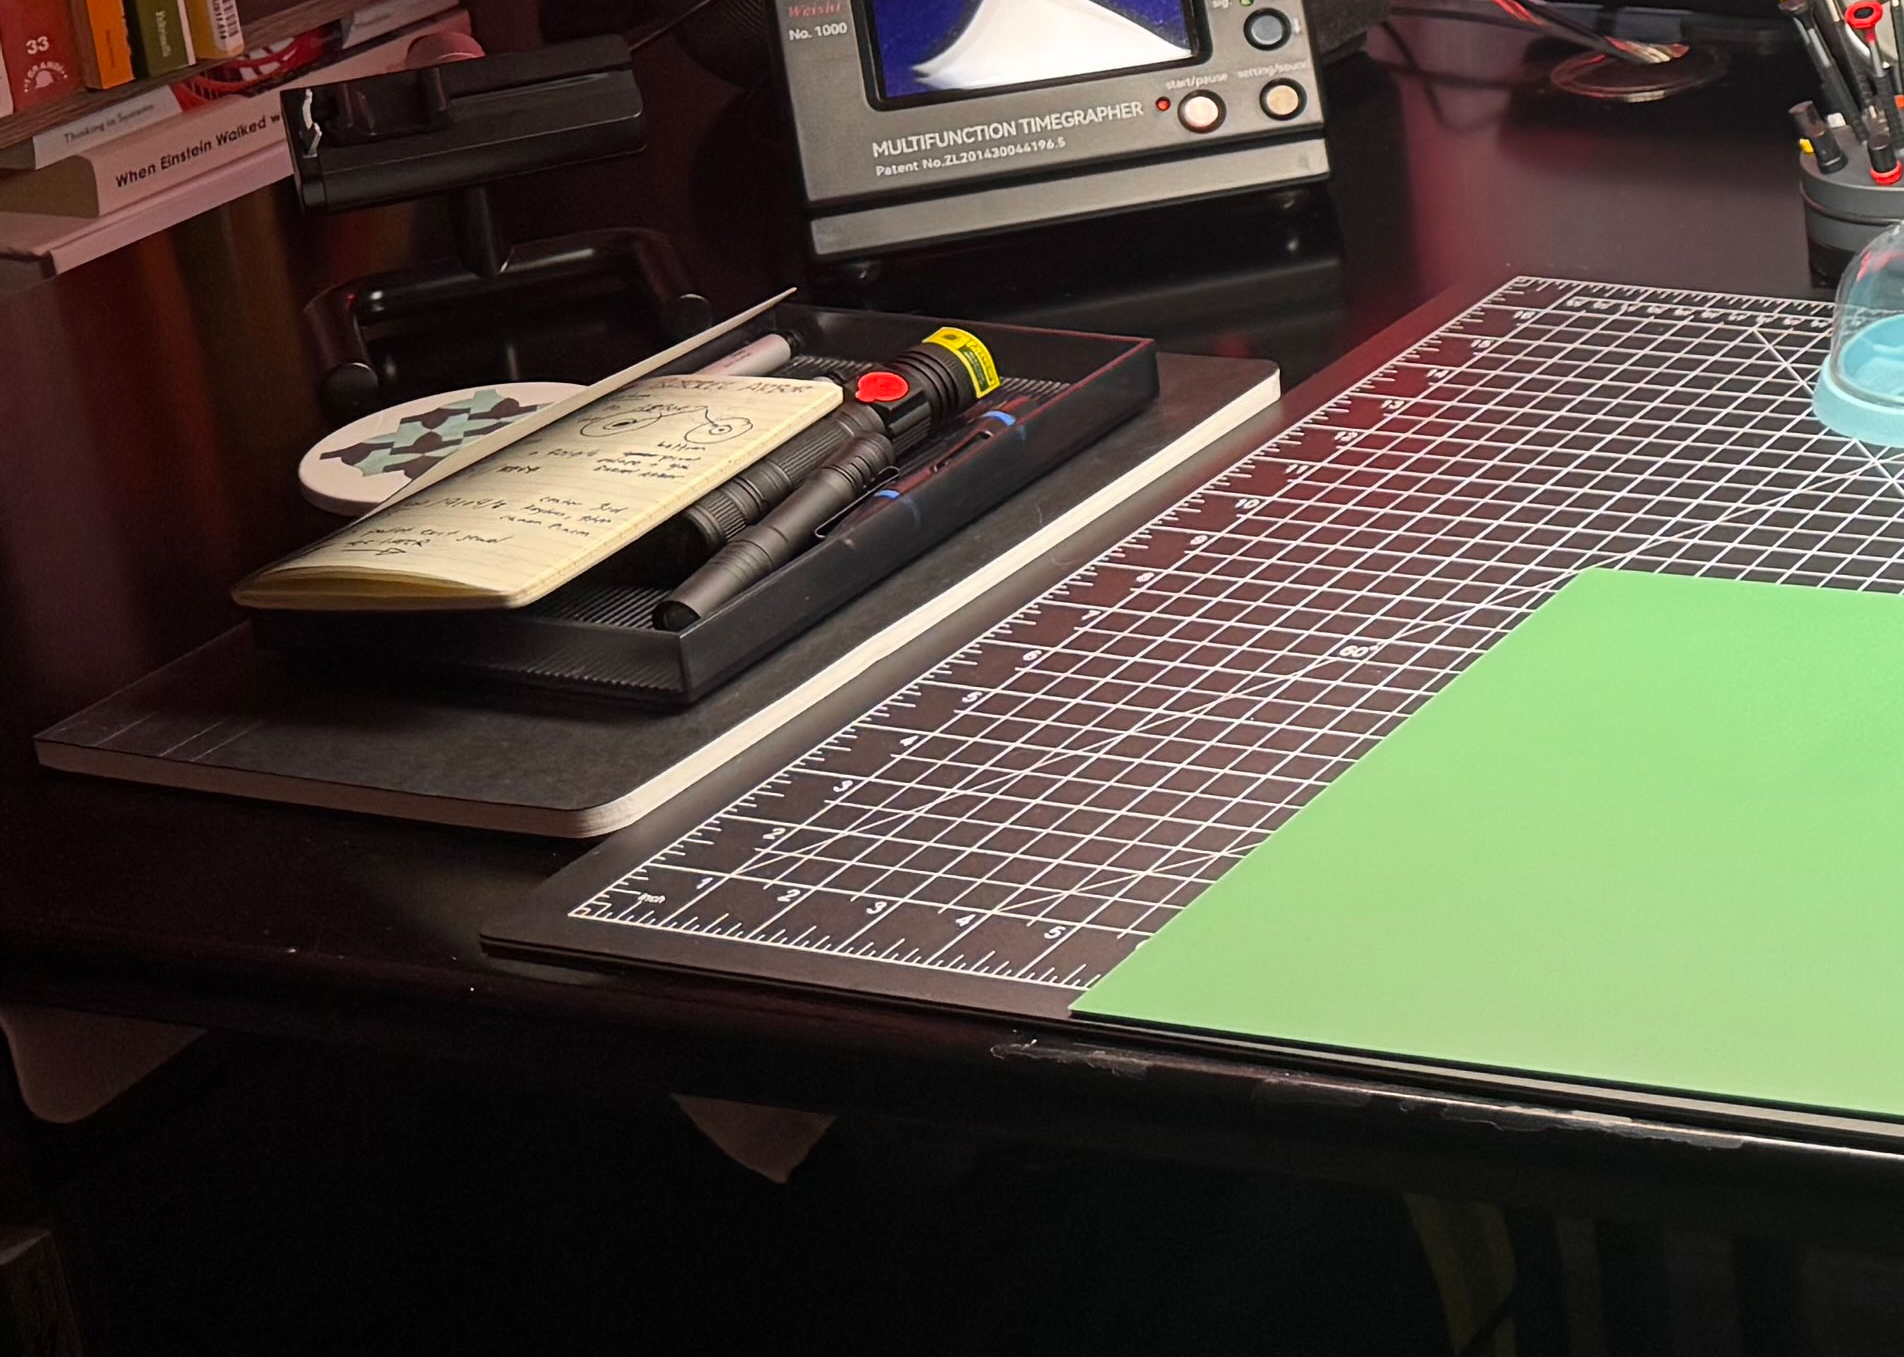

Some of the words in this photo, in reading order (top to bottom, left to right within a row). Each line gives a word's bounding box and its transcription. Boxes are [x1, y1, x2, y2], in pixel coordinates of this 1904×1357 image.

[788, 27, 812, 41] No.
[814, 21, 848, 39] 1000
[26, 36, 50, 55] 33
[1165, 72, 1229, 91] start/pause
[872, 119, 1017, 159] MULTIFUNCTION
[1020, 100, 1145, 137] TIMEGRAPHER
[115, 162, 156, 188] When
[160, 140, 212, 170] Einstein
[215, 116, 267, 148] Walked
[875, 159, 919, 178] Patent
[1333, 431, 1359, 442] 12
[1284, 463, 1312, 474] 11
[1234, 498, 1261, 510] 10
[1081, 609, 1102, 621] 7
[1022, 649, 1043, 662] 6
[961, 691, 983, 704] 5
[899, 735, 919, 747] 4
[833, 780, 853, 793] 3
[762, 827, 786, 841] 2
[696, 876, 716, 890] 1
[776, 888, 802, 903] 2
[866, 900, 889, 915] 3
[954, 913, 975, 928] 4
[1044, 925, 1065, 940] 5
